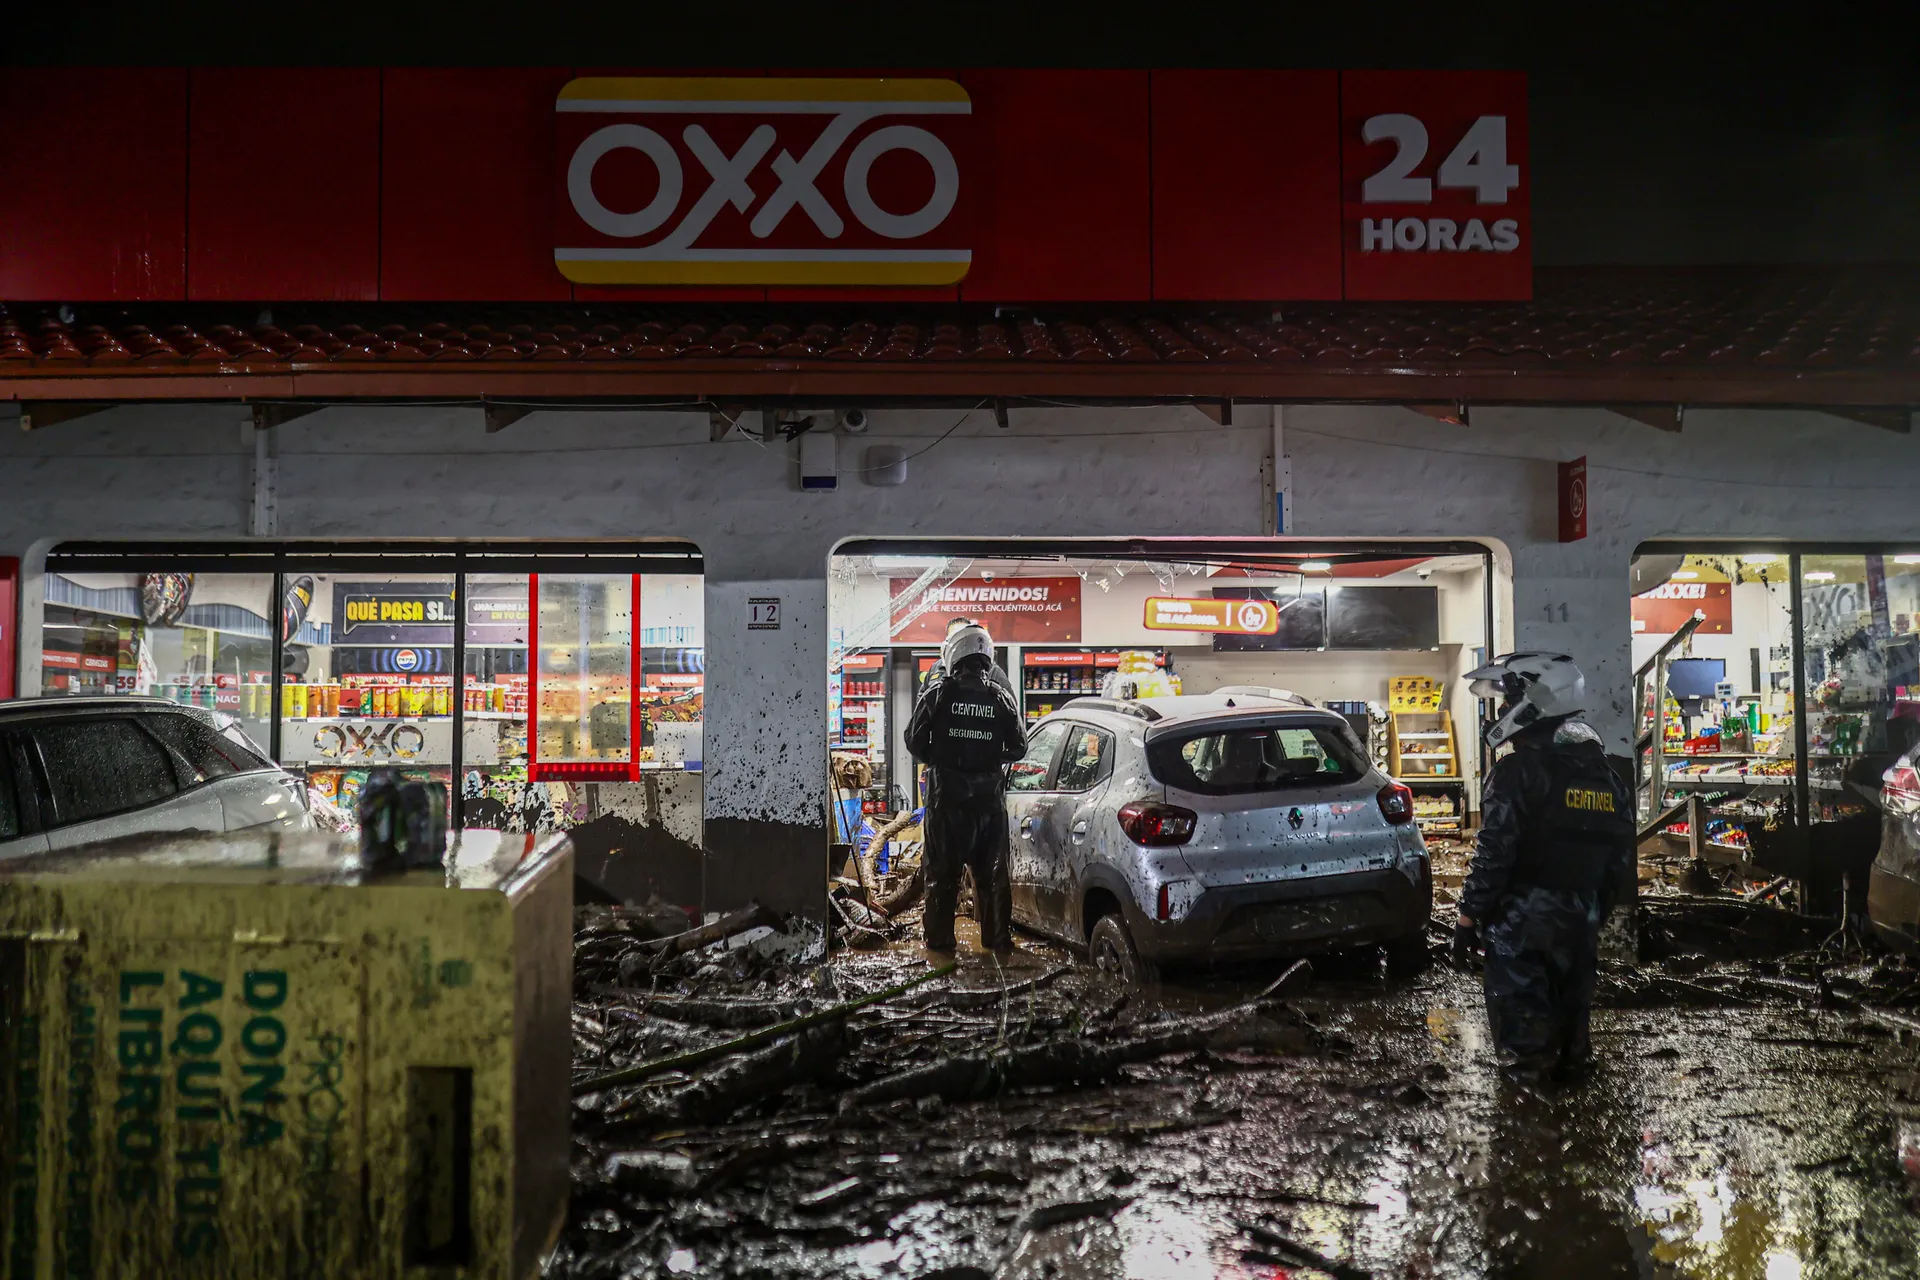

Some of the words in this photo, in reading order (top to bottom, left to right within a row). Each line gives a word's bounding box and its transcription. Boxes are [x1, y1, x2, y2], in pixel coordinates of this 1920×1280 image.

[1361, 113, 1519, 204] 24
[566, 113, 961, 249] OXXO
[1361, 217, 1520, 252] HORAS
[347, 597, 377, 621] QUÉ
[381, 602, 424, 621] PASA
[752, 605, 777, 622] 12
[941, 604, 984, 613] NECESITES,
[985, 602, 1044, 612] ENCUÉNTRALO
[1045, 602, 1062, 612] ACÁ
[951, 702, 996, 718] CENTINEL
[313, 723, 424, 759] OXXO
[948, 728, 993, 741] SEGURIDAD
[1565, 788, 1615, 812] CENTINEL
[169, 970, 234, 1125] AQUÍ
[239, 970, 288, 1148] DONA
[115, 970, 165, 1204] LIBROS
[174, 1142, 221, 1259] TUS
